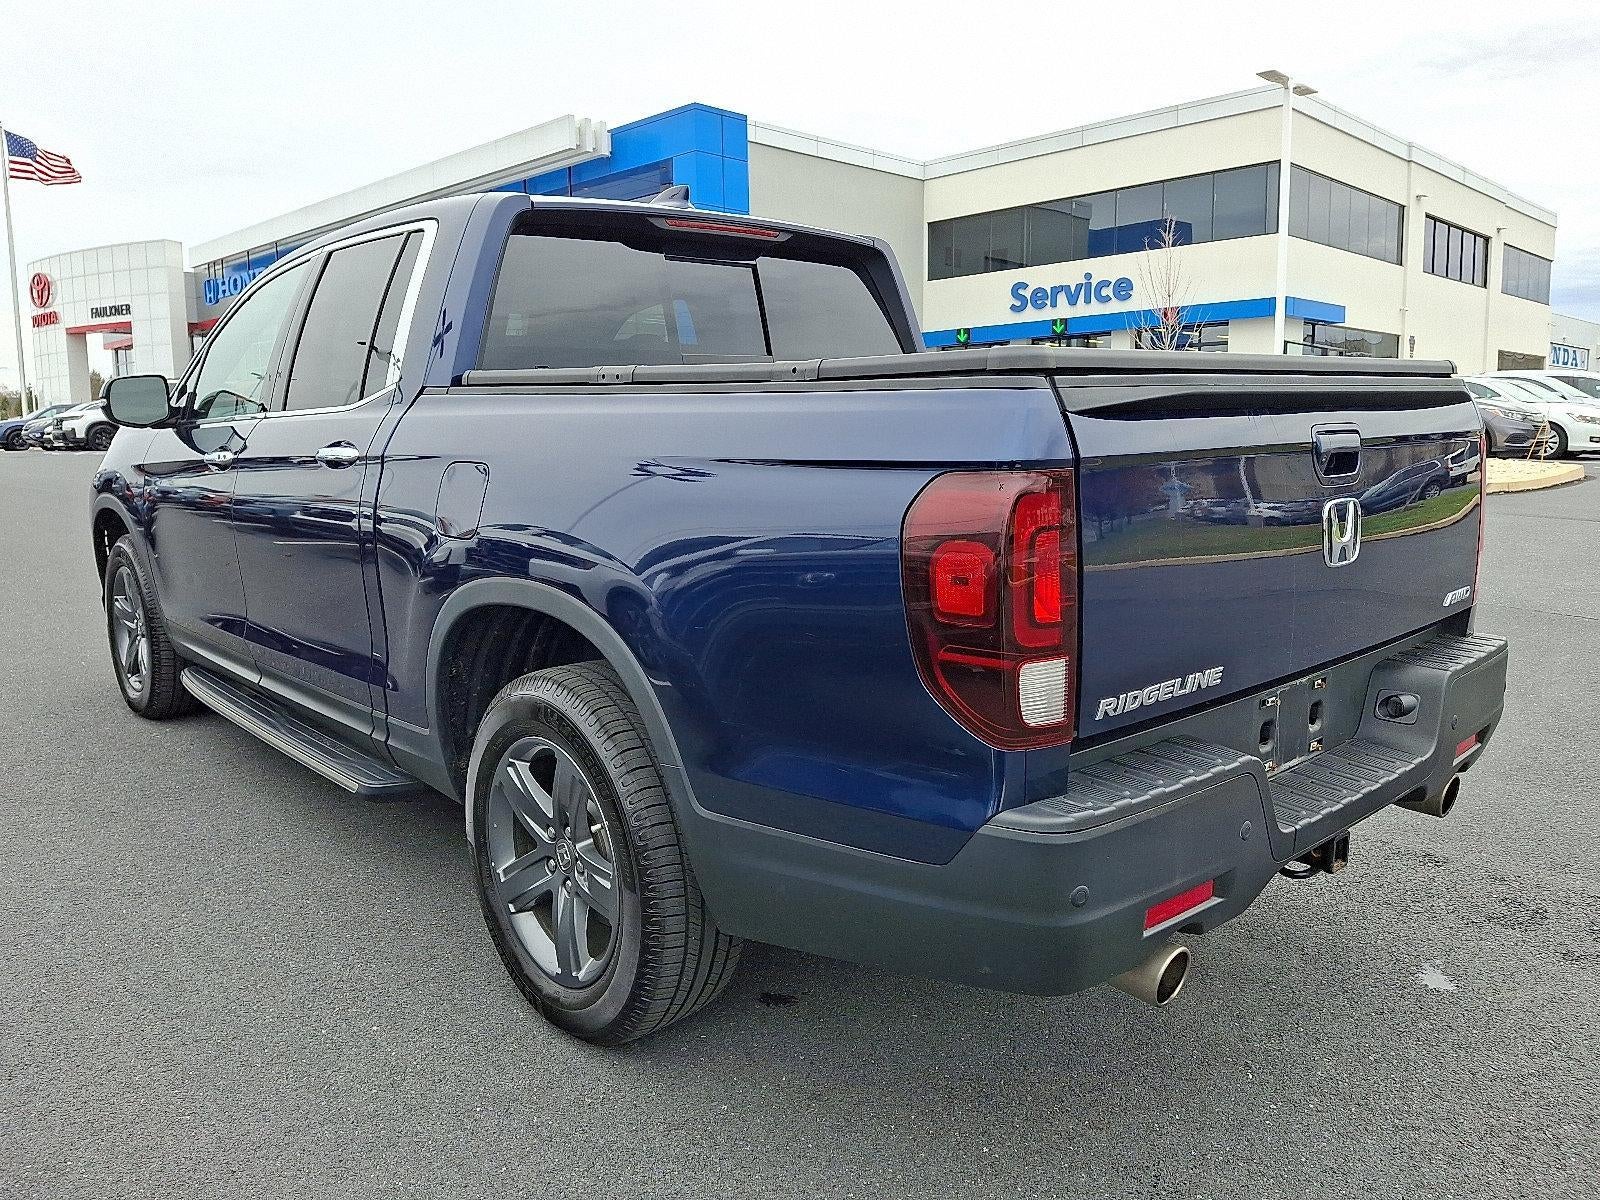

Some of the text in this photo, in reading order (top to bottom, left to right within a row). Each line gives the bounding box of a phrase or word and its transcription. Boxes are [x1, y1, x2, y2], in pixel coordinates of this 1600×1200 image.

[1009, 272, 1134, 313] Service
[32, 310, 59, 328] TOYOTA
[90, 303, 131, 319] FAULKNER
[1095, 666, 1224, 721] RIDGELINE
